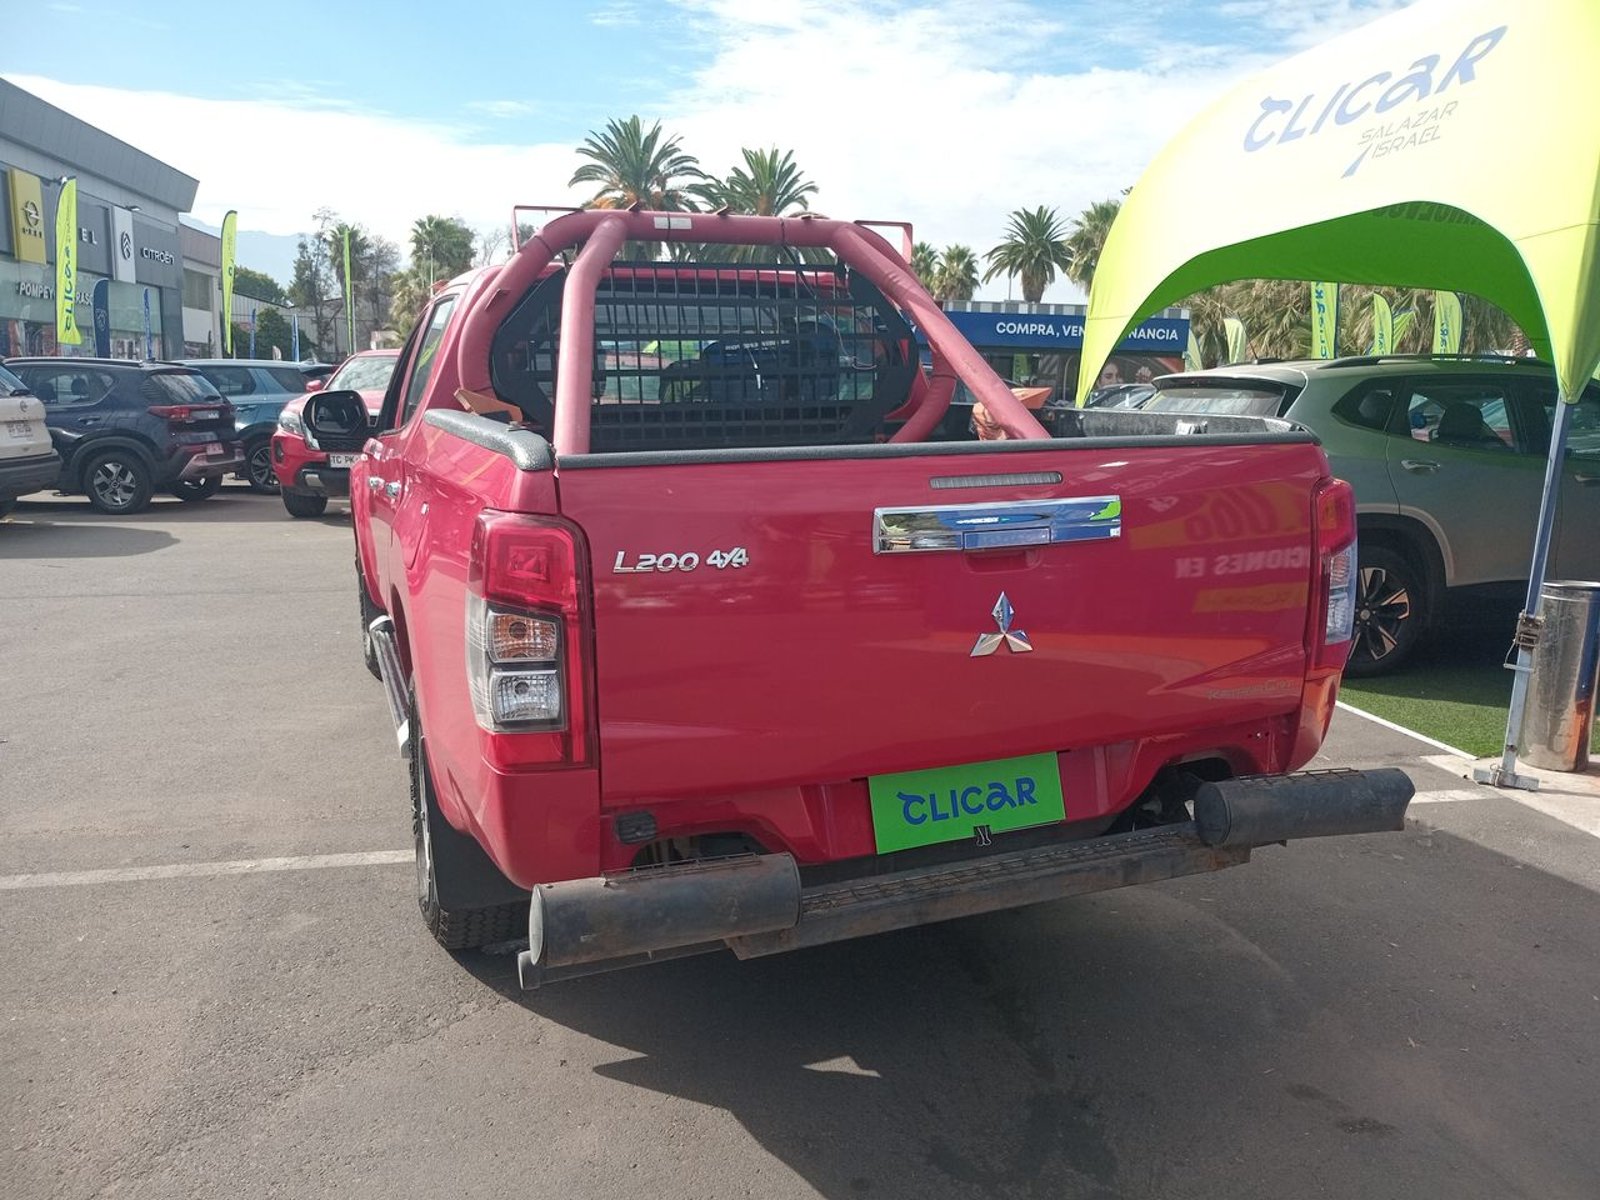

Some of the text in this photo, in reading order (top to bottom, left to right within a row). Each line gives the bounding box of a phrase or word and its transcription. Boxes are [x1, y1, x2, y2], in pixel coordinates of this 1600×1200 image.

[1358, 100, 1458, 145] SALAZAR
[1372, 124, 1441, 159] ISRAEL
[995, 321, 1178, 341] COMPRA, VEN NANCIA
[613, 551, 700, 573] L200
[896, 777, 1038, 825] CLICAR
